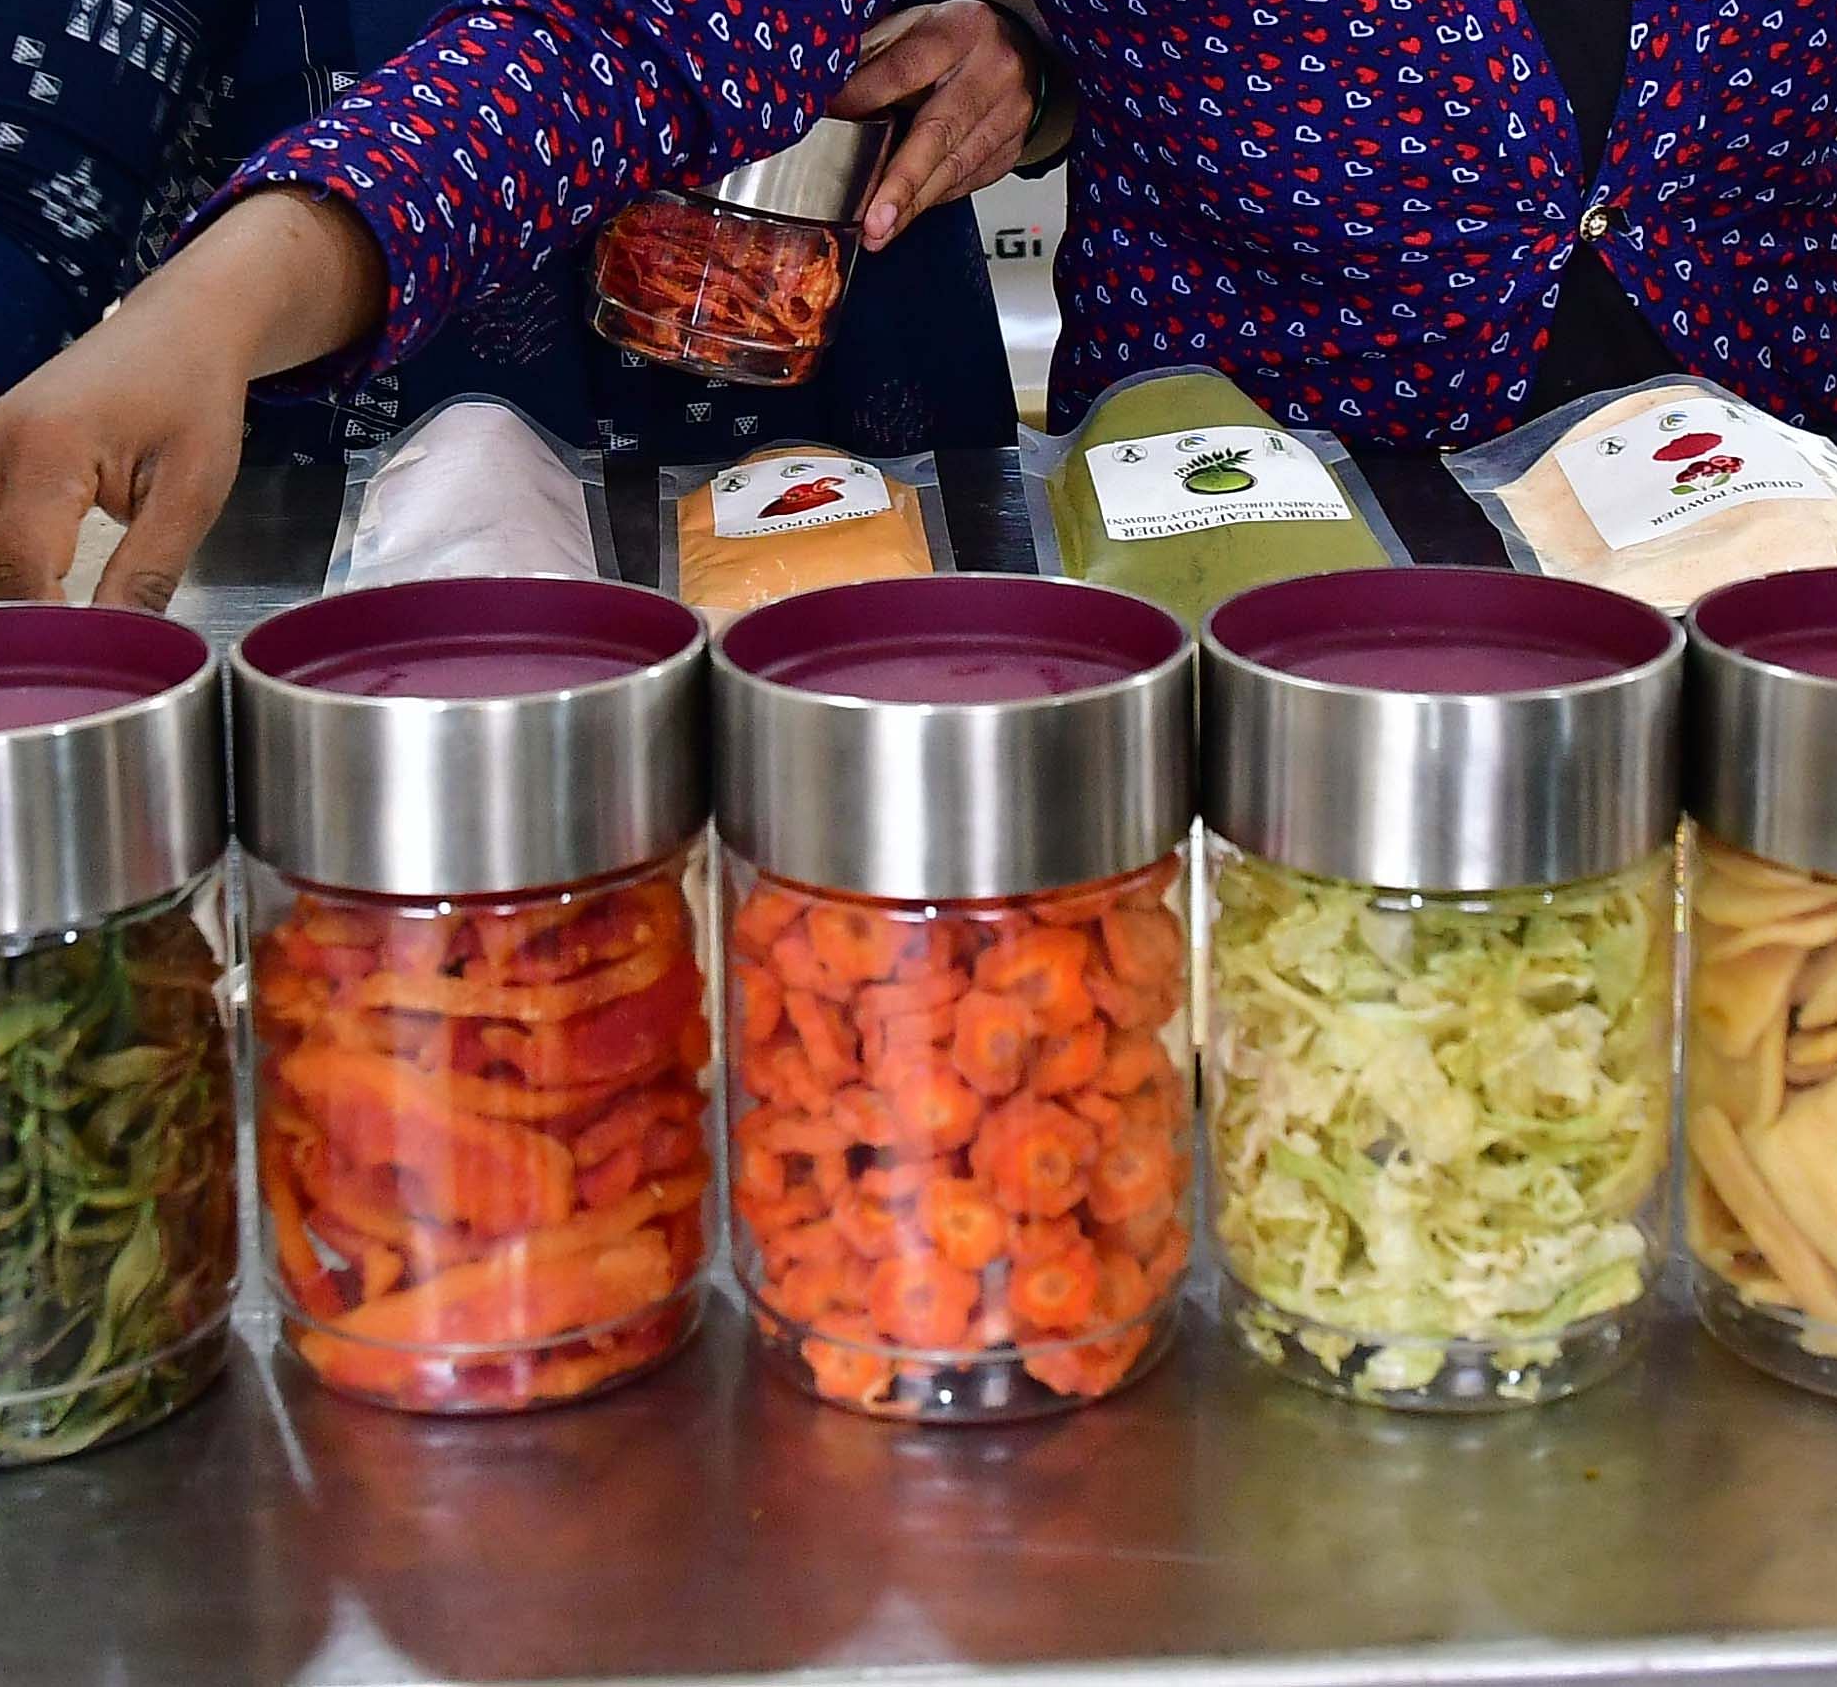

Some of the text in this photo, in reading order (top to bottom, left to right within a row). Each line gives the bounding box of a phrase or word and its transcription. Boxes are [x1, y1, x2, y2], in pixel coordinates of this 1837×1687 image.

[985, 225, 1043, 260] Gi
[808, 507, 890, 525] OMATO
[1651, 481, 1803, 526] CHERRY POWDER
[1121, 517, 1209, 538] POWDER
